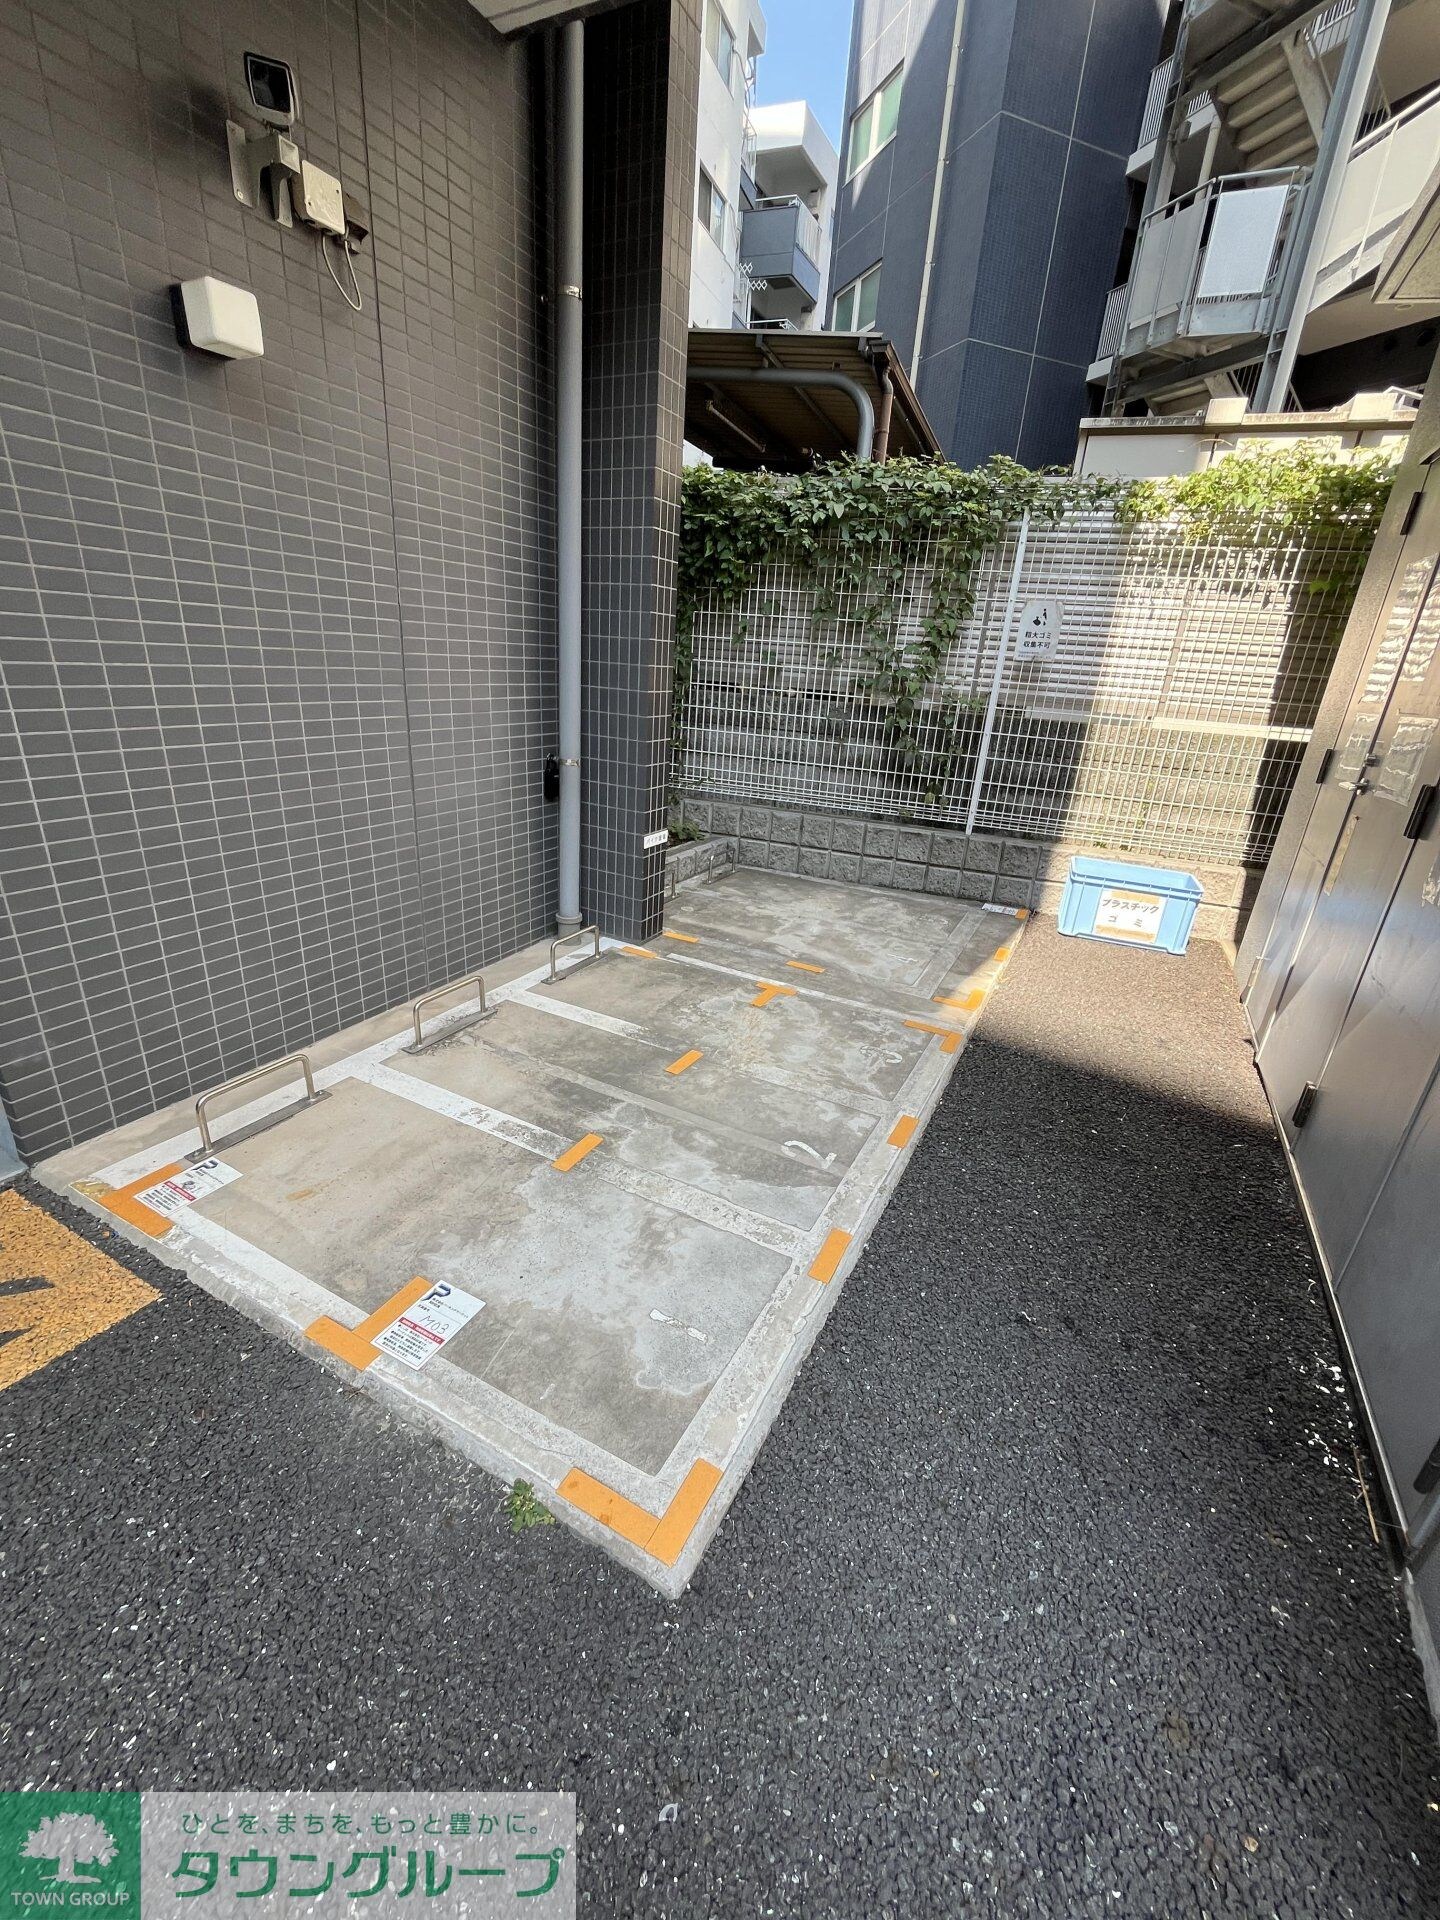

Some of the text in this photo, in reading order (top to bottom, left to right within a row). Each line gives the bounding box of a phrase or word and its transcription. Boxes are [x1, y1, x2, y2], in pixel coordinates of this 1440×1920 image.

[1102, 898, 1159, 914] プラスチック
[781, 1140, 838, 1170] 2
